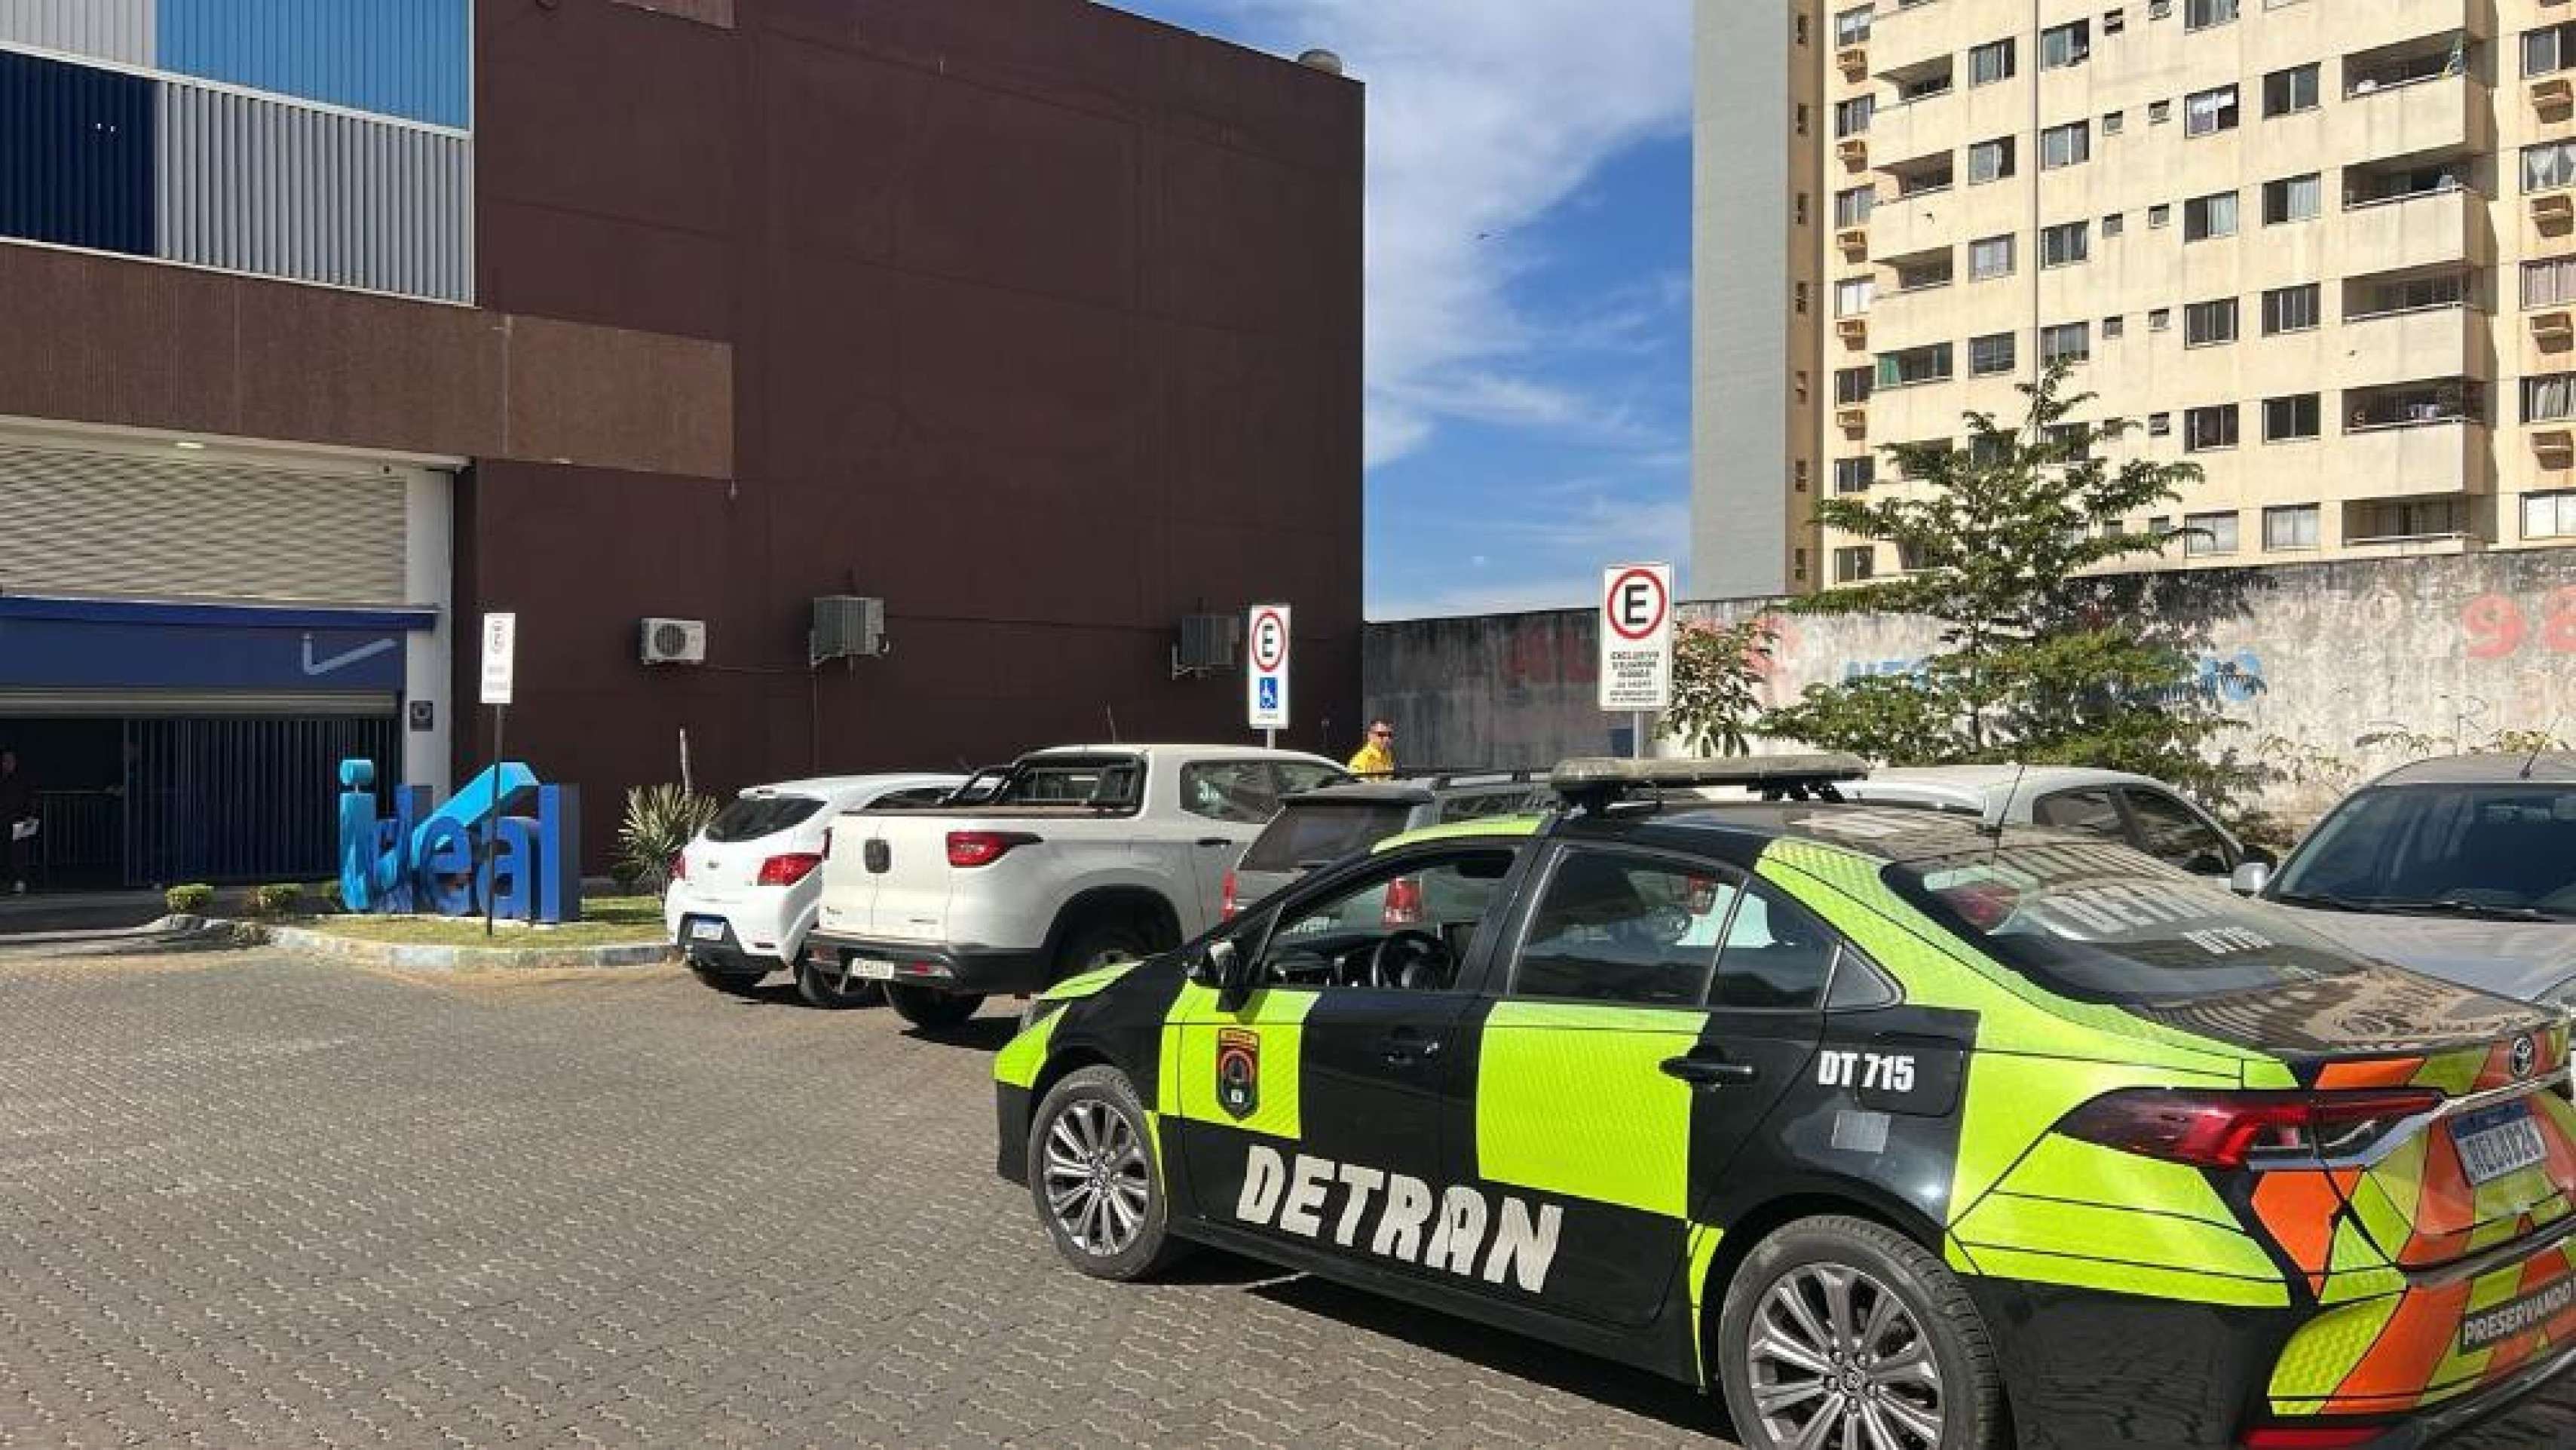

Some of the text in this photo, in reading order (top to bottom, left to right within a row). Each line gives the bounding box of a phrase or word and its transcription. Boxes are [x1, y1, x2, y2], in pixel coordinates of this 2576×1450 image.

[1625, 584, 1649, 624] E
[1261, 624, 1274, 658] E
[1818, 1050, 1915, 1090] DT 715
[1236, 1145, 1564, 1294] DETRAN
[2464, 1281, 2571, 1345] PRESERVANDO
